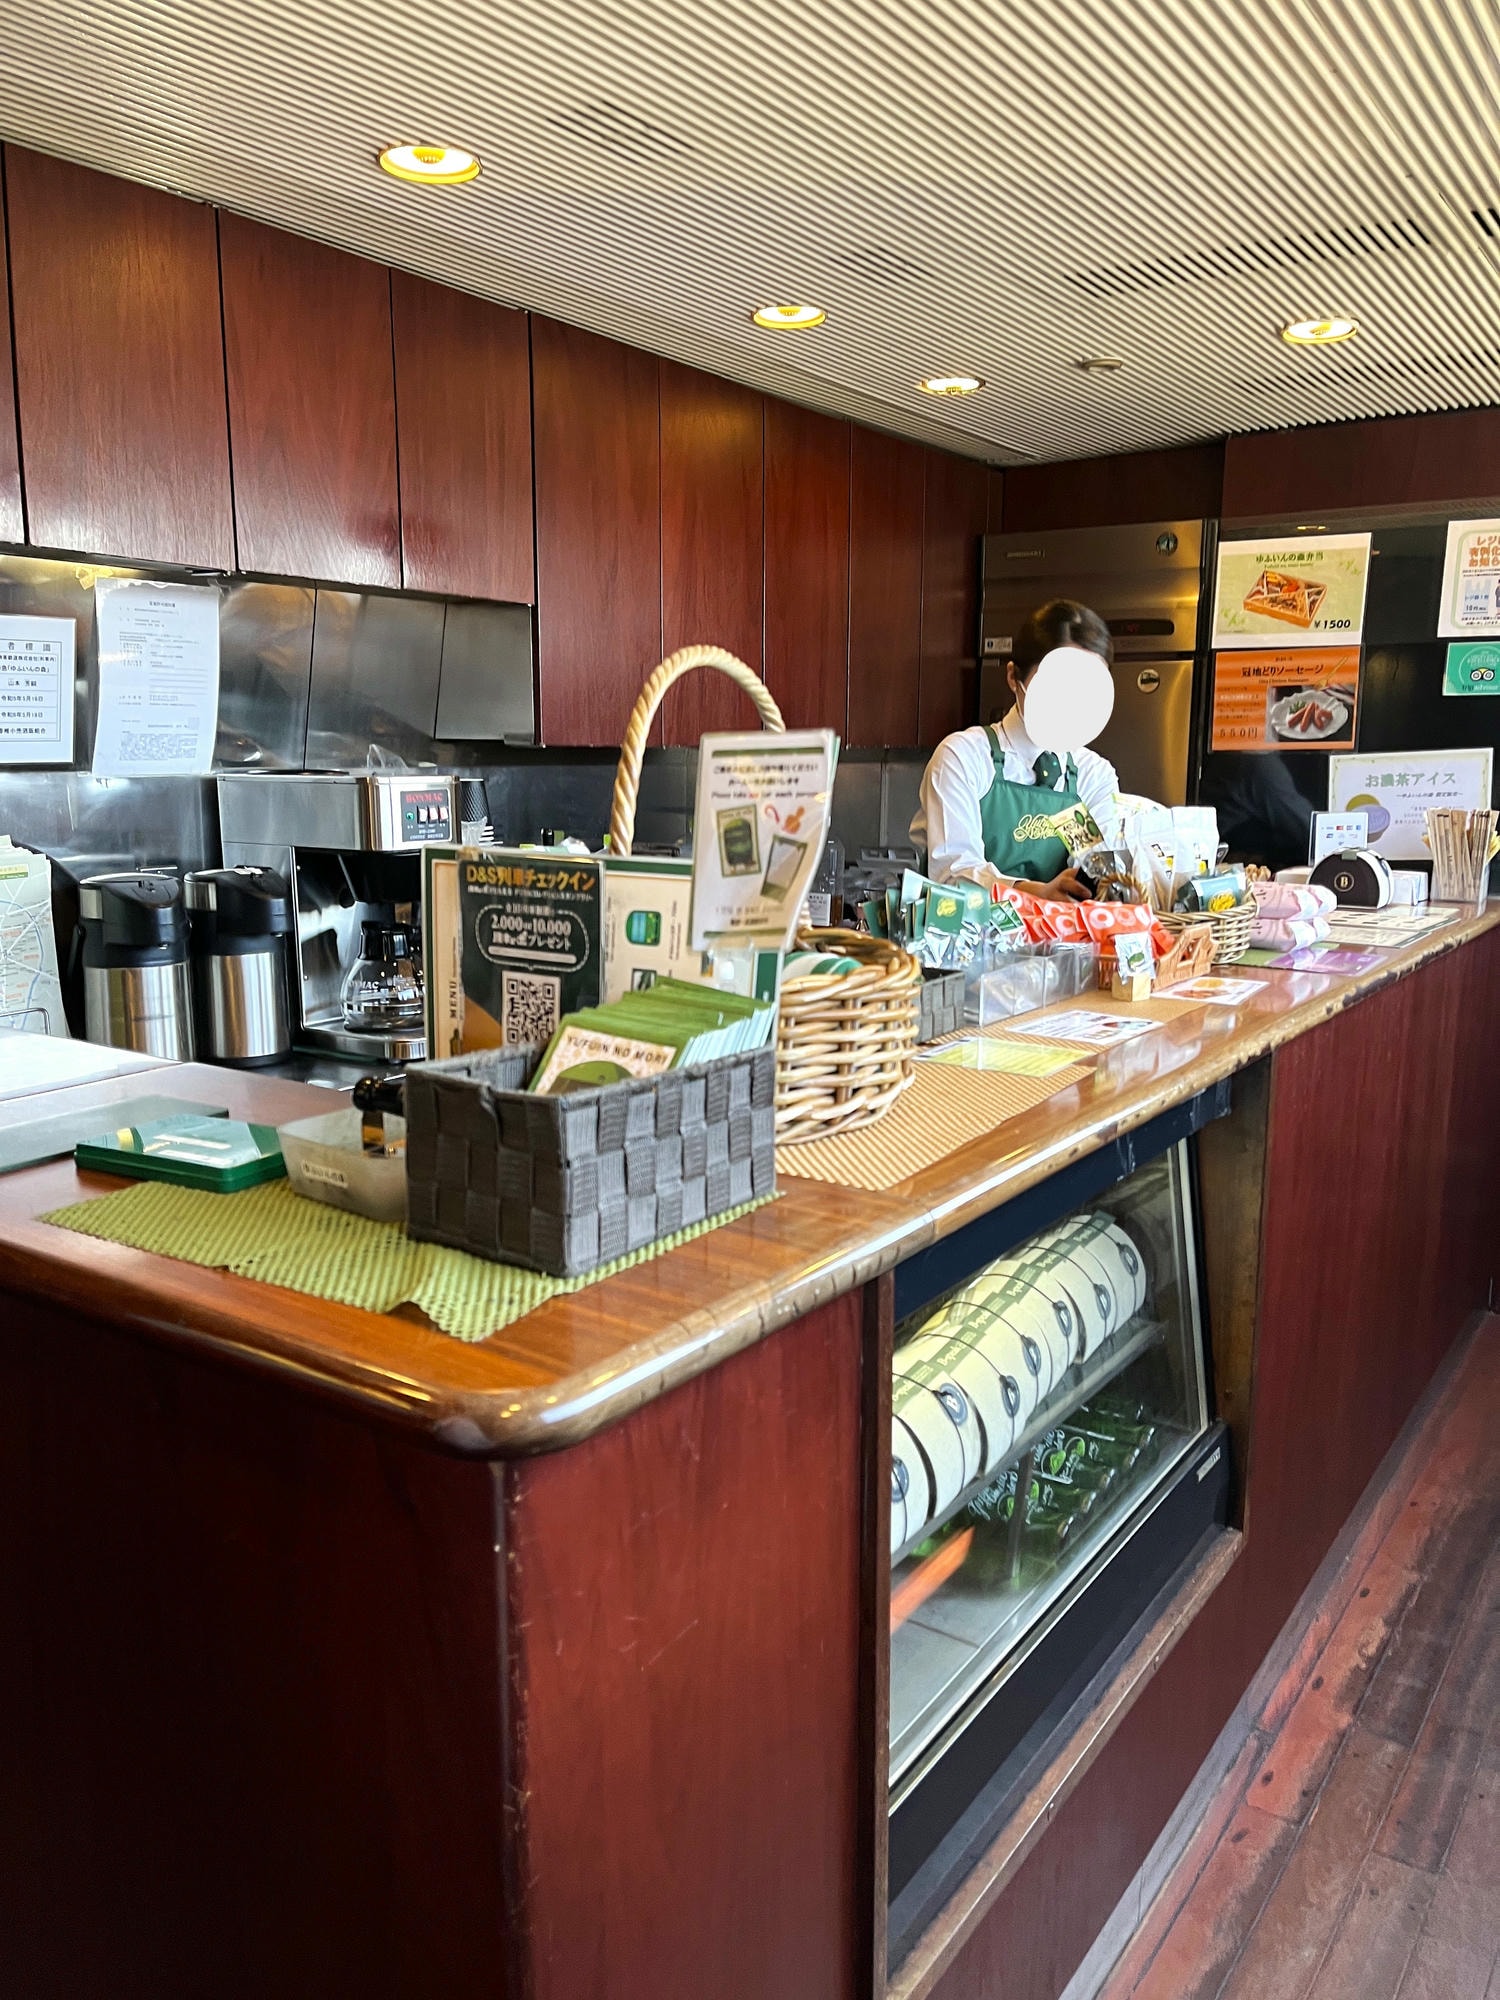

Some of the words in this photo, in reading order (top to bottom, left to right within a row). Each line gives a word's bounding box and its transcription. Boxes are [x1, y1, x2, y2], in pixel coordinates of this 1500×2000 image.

[1255, 551, 1324, 563] ゆふいんの森弁当
[1365, 772, 1456, 788] お濃茶アイス
